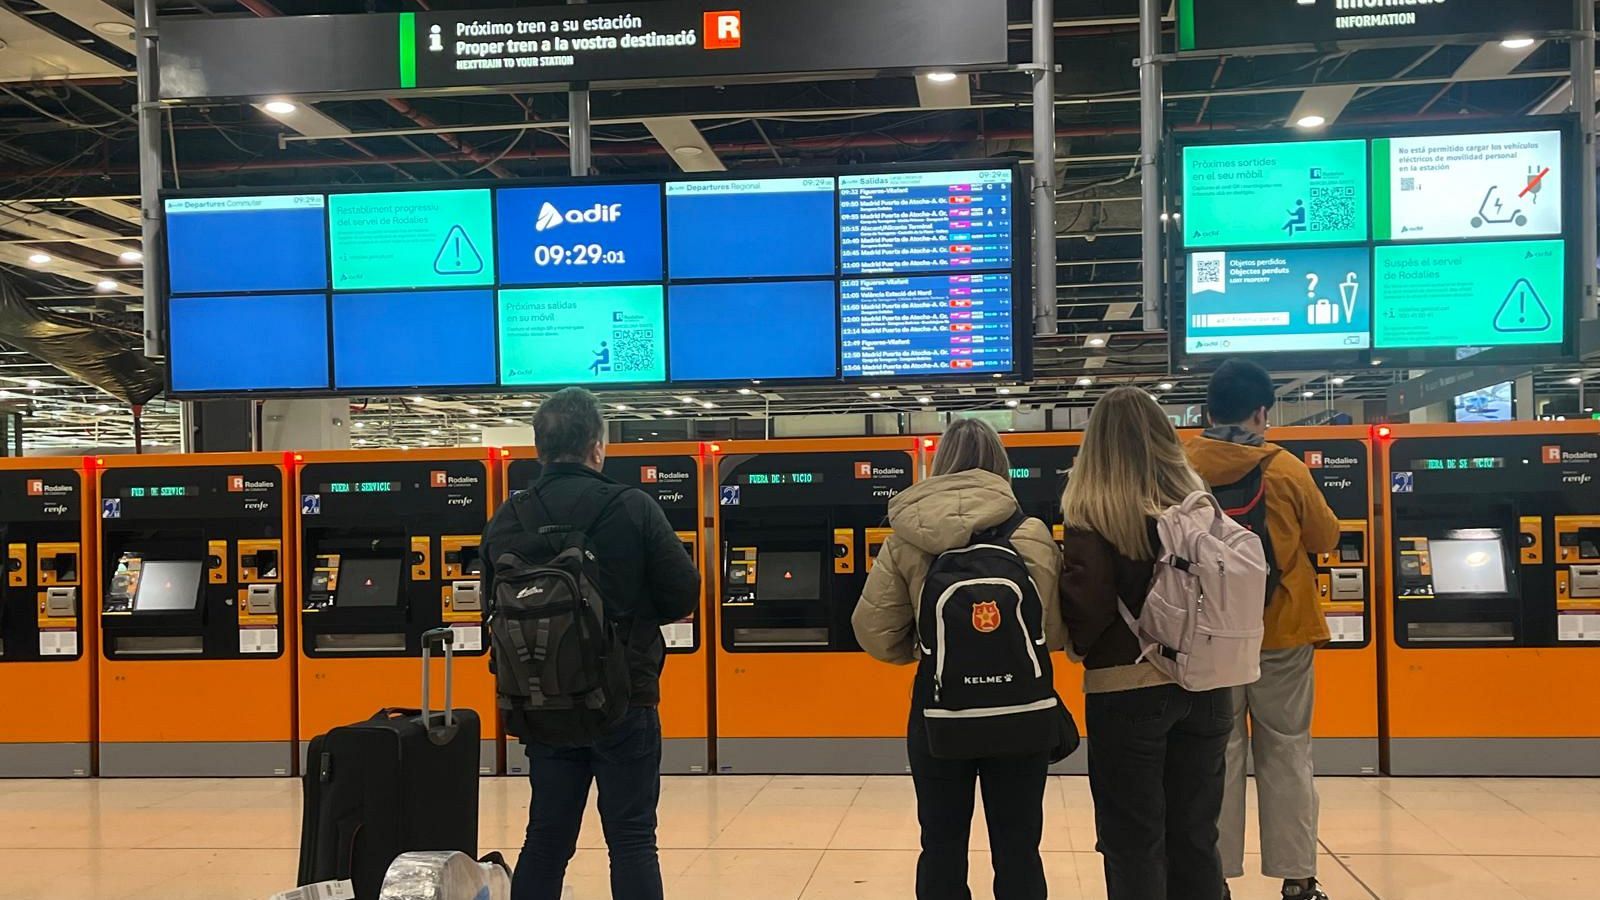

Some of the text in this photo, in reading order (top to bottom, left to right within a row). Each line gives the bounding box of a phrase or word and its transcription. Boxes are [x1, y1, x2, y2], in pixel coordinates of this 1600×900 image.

[457, 14, 642, 36] Próximo tren a su estación
[1336, 12, 1415, 28] INFORMATION
[718, 16, 740, 39] R
[456, 30, 696, 57] Proper tren a la vostra destinació
[504, 58, 515, 68] TO
[516, 57, 539, 67] YOUR
[540, 55, 574, 67] STATION
[1410, 146, 1426, 154] está
[1428, 145, 1464, 155] permitido
[1466, 144, 1489, 153] cargar
[1491, 143, 1501, 151] los
[1504, 142, 1539, 151] vehículos
[1399, 152, 1518, 163] eléctricos de movilidad personal
[1238, 158, 1277, 168] sortides
[1419, 163, 1450, 171] estación
[860, 177, 889, 185] Salidas
[1206, 172, 1215, 180] el
[1218, 172, 1234, 180] seu
[686, 182, 761, 192] Departures Regional
[184, 200, 226, 209] Departures
[337, 204, 439, 215] Restabliment progressiu
[565, 204, 622, 223] adif
[337, 216, 429, 226] del servei de Rodalies
[534, 244, 626, 266] 09:29:01
[1230, 258, 1287, 268] Objetos perdidos
[1421, 258, 1431, 266] el
[1433, 257, 1462, 266] servei
[1230, 267, 1290, 276] Objectes perduts
[1384, 270, 1440, 280] de Rodalies
[506, 301, 577, 311] Próximas salidas
[520, 314, 530, 322] su
[531, 312, 555, 322] móvil
[1550, 448, 1560, 460] R
[1562, 452, 1598, 460] Rodalies
[1311, 454, 1322, 465] R
[1447, 459, 1457, 469] DE
[647, 469, 657, 479] R
[861, 464, 871, 475] R
[436, 473, 446, 484] R
[750, 474, 768, 484] FUERA
[772, 474, 780, 483] DE
[1562, 470, 1591, 485] renfe
[33, 482, 43, 492] R
[234, 478, 244, 489] R
[1324, 478, 1352, 489] renfe
[659, 492, 684, 503] renfe
[873, 488, 899, 498] renfe
[245, 500, 269, 512] renfe
[448, 497, 473, 507] renfe
[44, 504, 68, 515] renfe
[964, 676, 1003, 685] KELME
